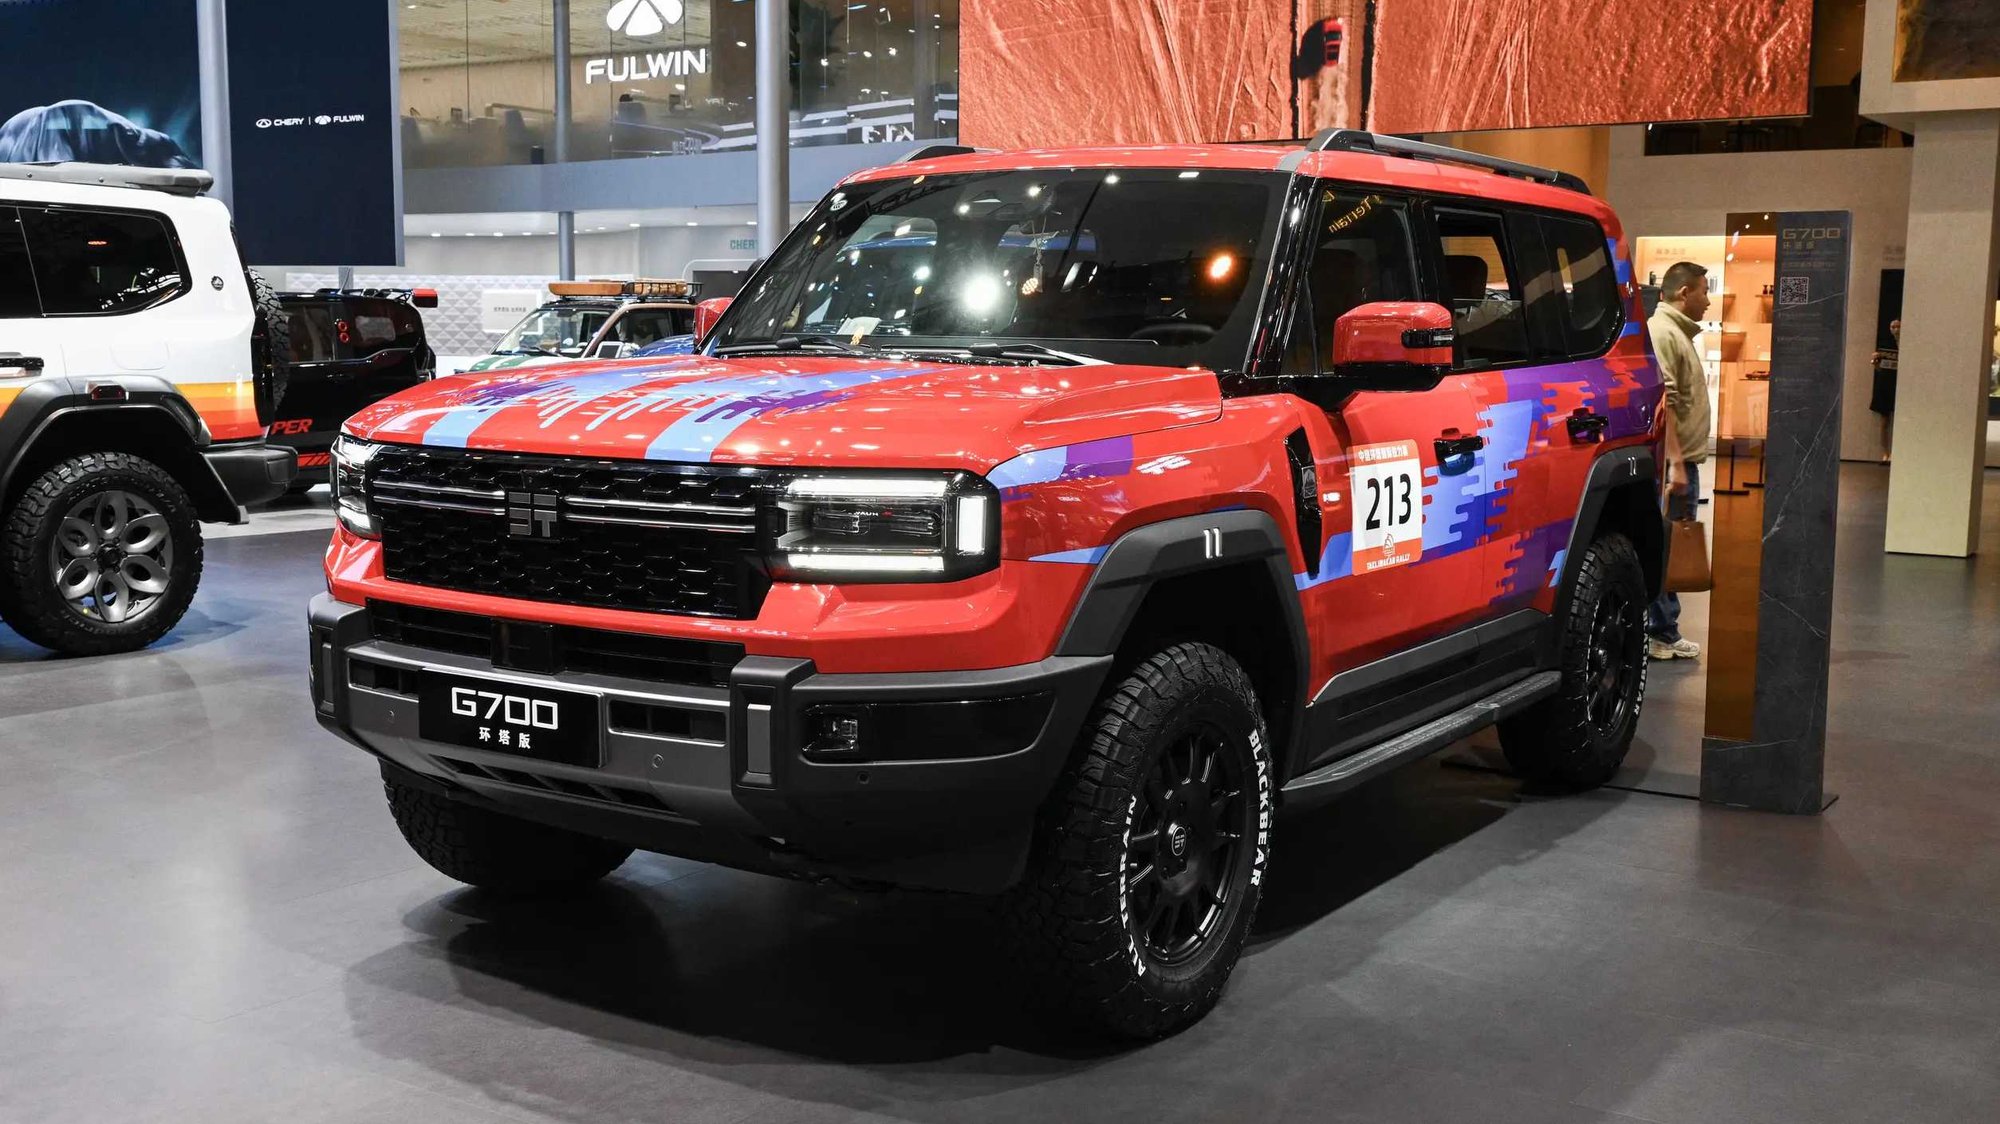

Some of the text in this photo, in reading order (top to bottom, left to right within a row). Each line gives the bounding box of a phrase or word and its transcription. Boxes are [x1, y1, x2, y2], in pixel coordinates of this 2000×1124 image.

[586, 48, 706, 84] FULWIN
[273, 115, 364, 126] CHERY FULWIN
[730, 239, 759, 250] CHER
[1782, 227, 1840, 240] G700
[1366, 473, 1411, 530] 213
[451, 686, 558, 730] G700
[479, 726, 531, 749] 环塔版
[1248, 728, 1270, 887] BLACKBEAR
[1119, 795, 1147, 977] ALL TERRAIN
